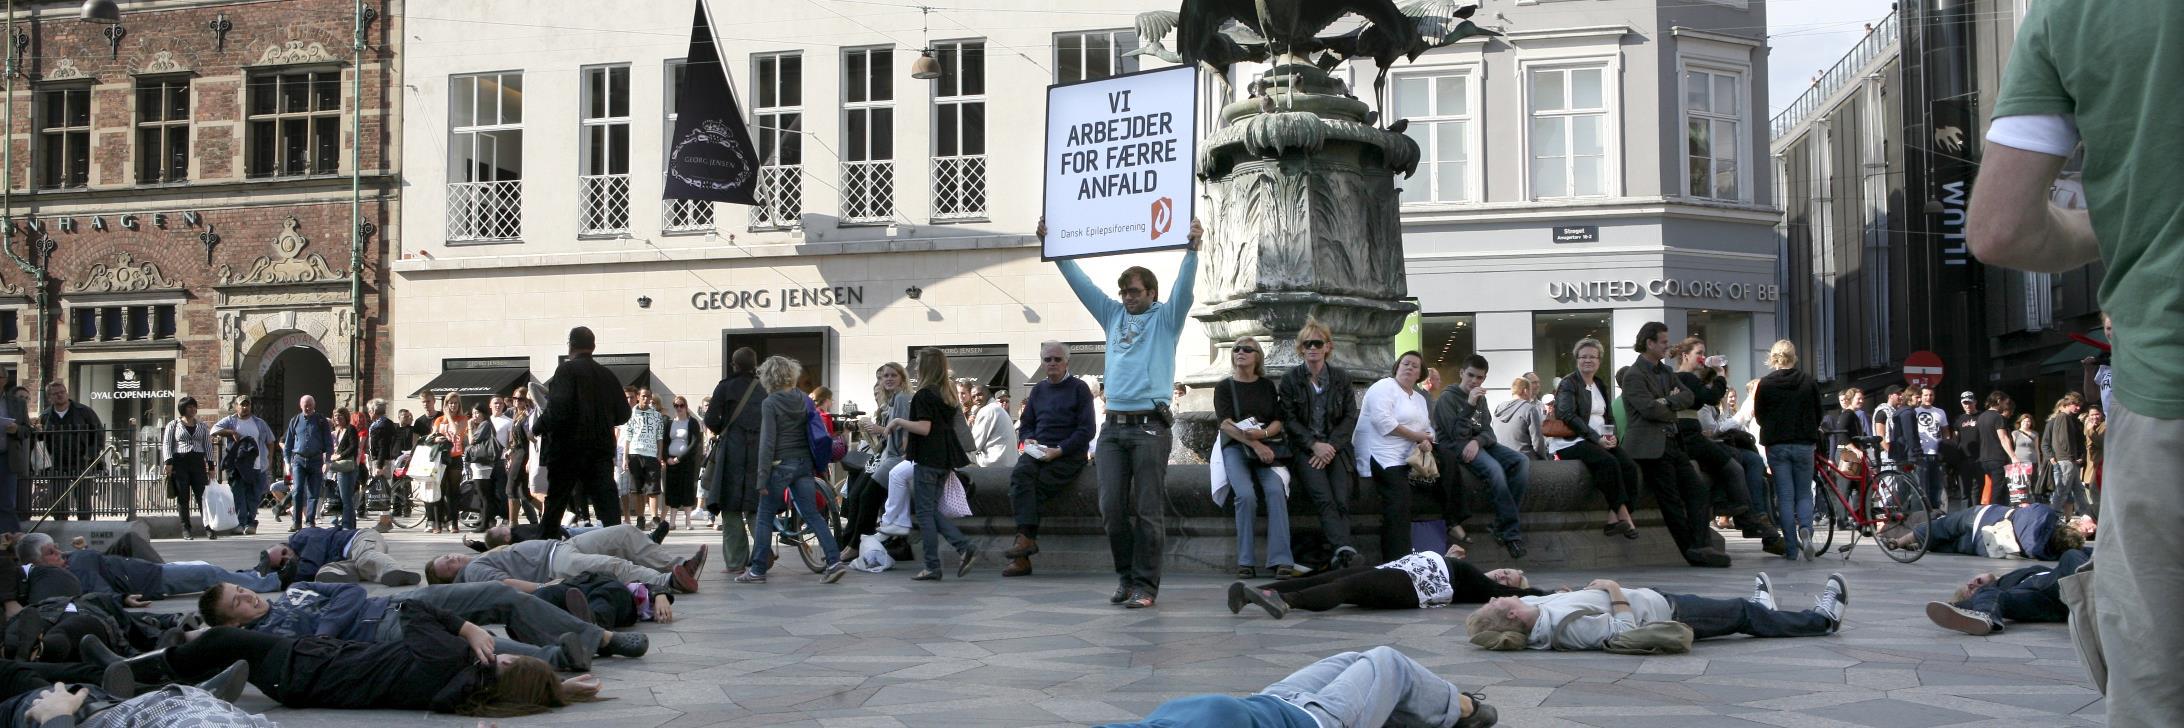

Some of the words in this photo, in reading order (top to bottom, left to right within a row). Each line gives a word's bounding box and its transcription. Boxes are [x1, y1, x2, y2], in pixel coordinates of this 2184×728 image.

[1108, 90, 1131, 113] VI
[1066, 112, 1173, 147] ARBEJDER
[684, 156, 708, 165] GEORG
[709, 160, 736, 168] JENSEN
[1061, 149, 1099, 175] FOR
[1106, 139, 1177, 169] FÆRRE
[1077, 170, 1158, 200] ANFALD
[1, 210, 198, 233] NHAGEN
[1060, 228, 1083, 239] Dansk
[1085, 223, 1146, 237] Epilepsiforening
[1943, 181, 1967, 264] ILLUM
[691, 289, 771, 310] GEORG
[780, 286, 863, 312] JENSEN
[1548, 279, 1638, 298] UNITED
[1647, 278, 1722, 299] COLORS
[1729, 282, 1751, 299] OF
[959, 347, 983, 355] JENSEN
[90, 391, 113, 400] OYAL
[113, 389, 175, 399] COPENHAGEN
